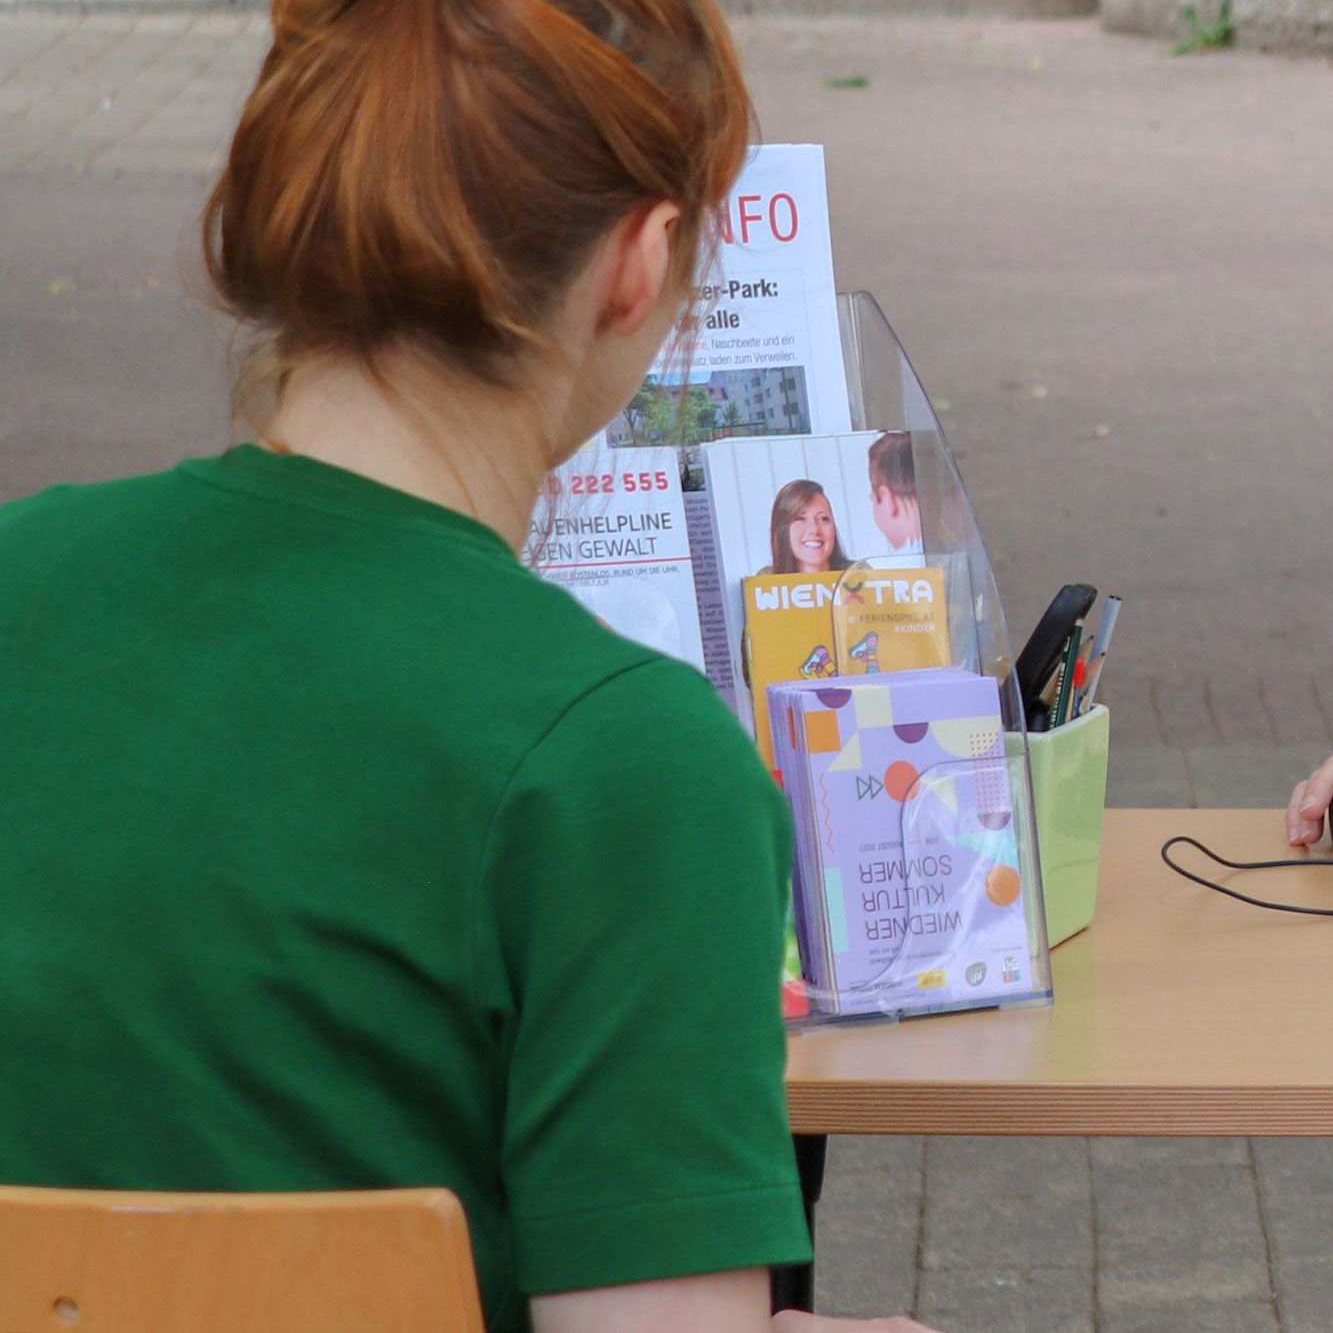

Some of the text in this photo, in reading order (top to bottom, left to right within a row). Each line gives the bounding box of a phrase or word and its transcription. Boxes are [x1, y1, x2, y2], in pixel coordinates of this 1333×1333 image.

[706, 310, 740, 330] alle
[763, 334, 780, 347] und
[781, 334, 795, 346] ein
[709, 354, 733, 366] laden
[734, 354, 752, 365] zum
[571, 474, 615, 495] 222
[623, 471, 669, 493] 555
[579, 537, 658, 560] GEWALT
[859, 854, 952, 884] SOMMER
[862, 883, 945, 913] KULTUR
[865, 910, 964, 941] WIEDNER
